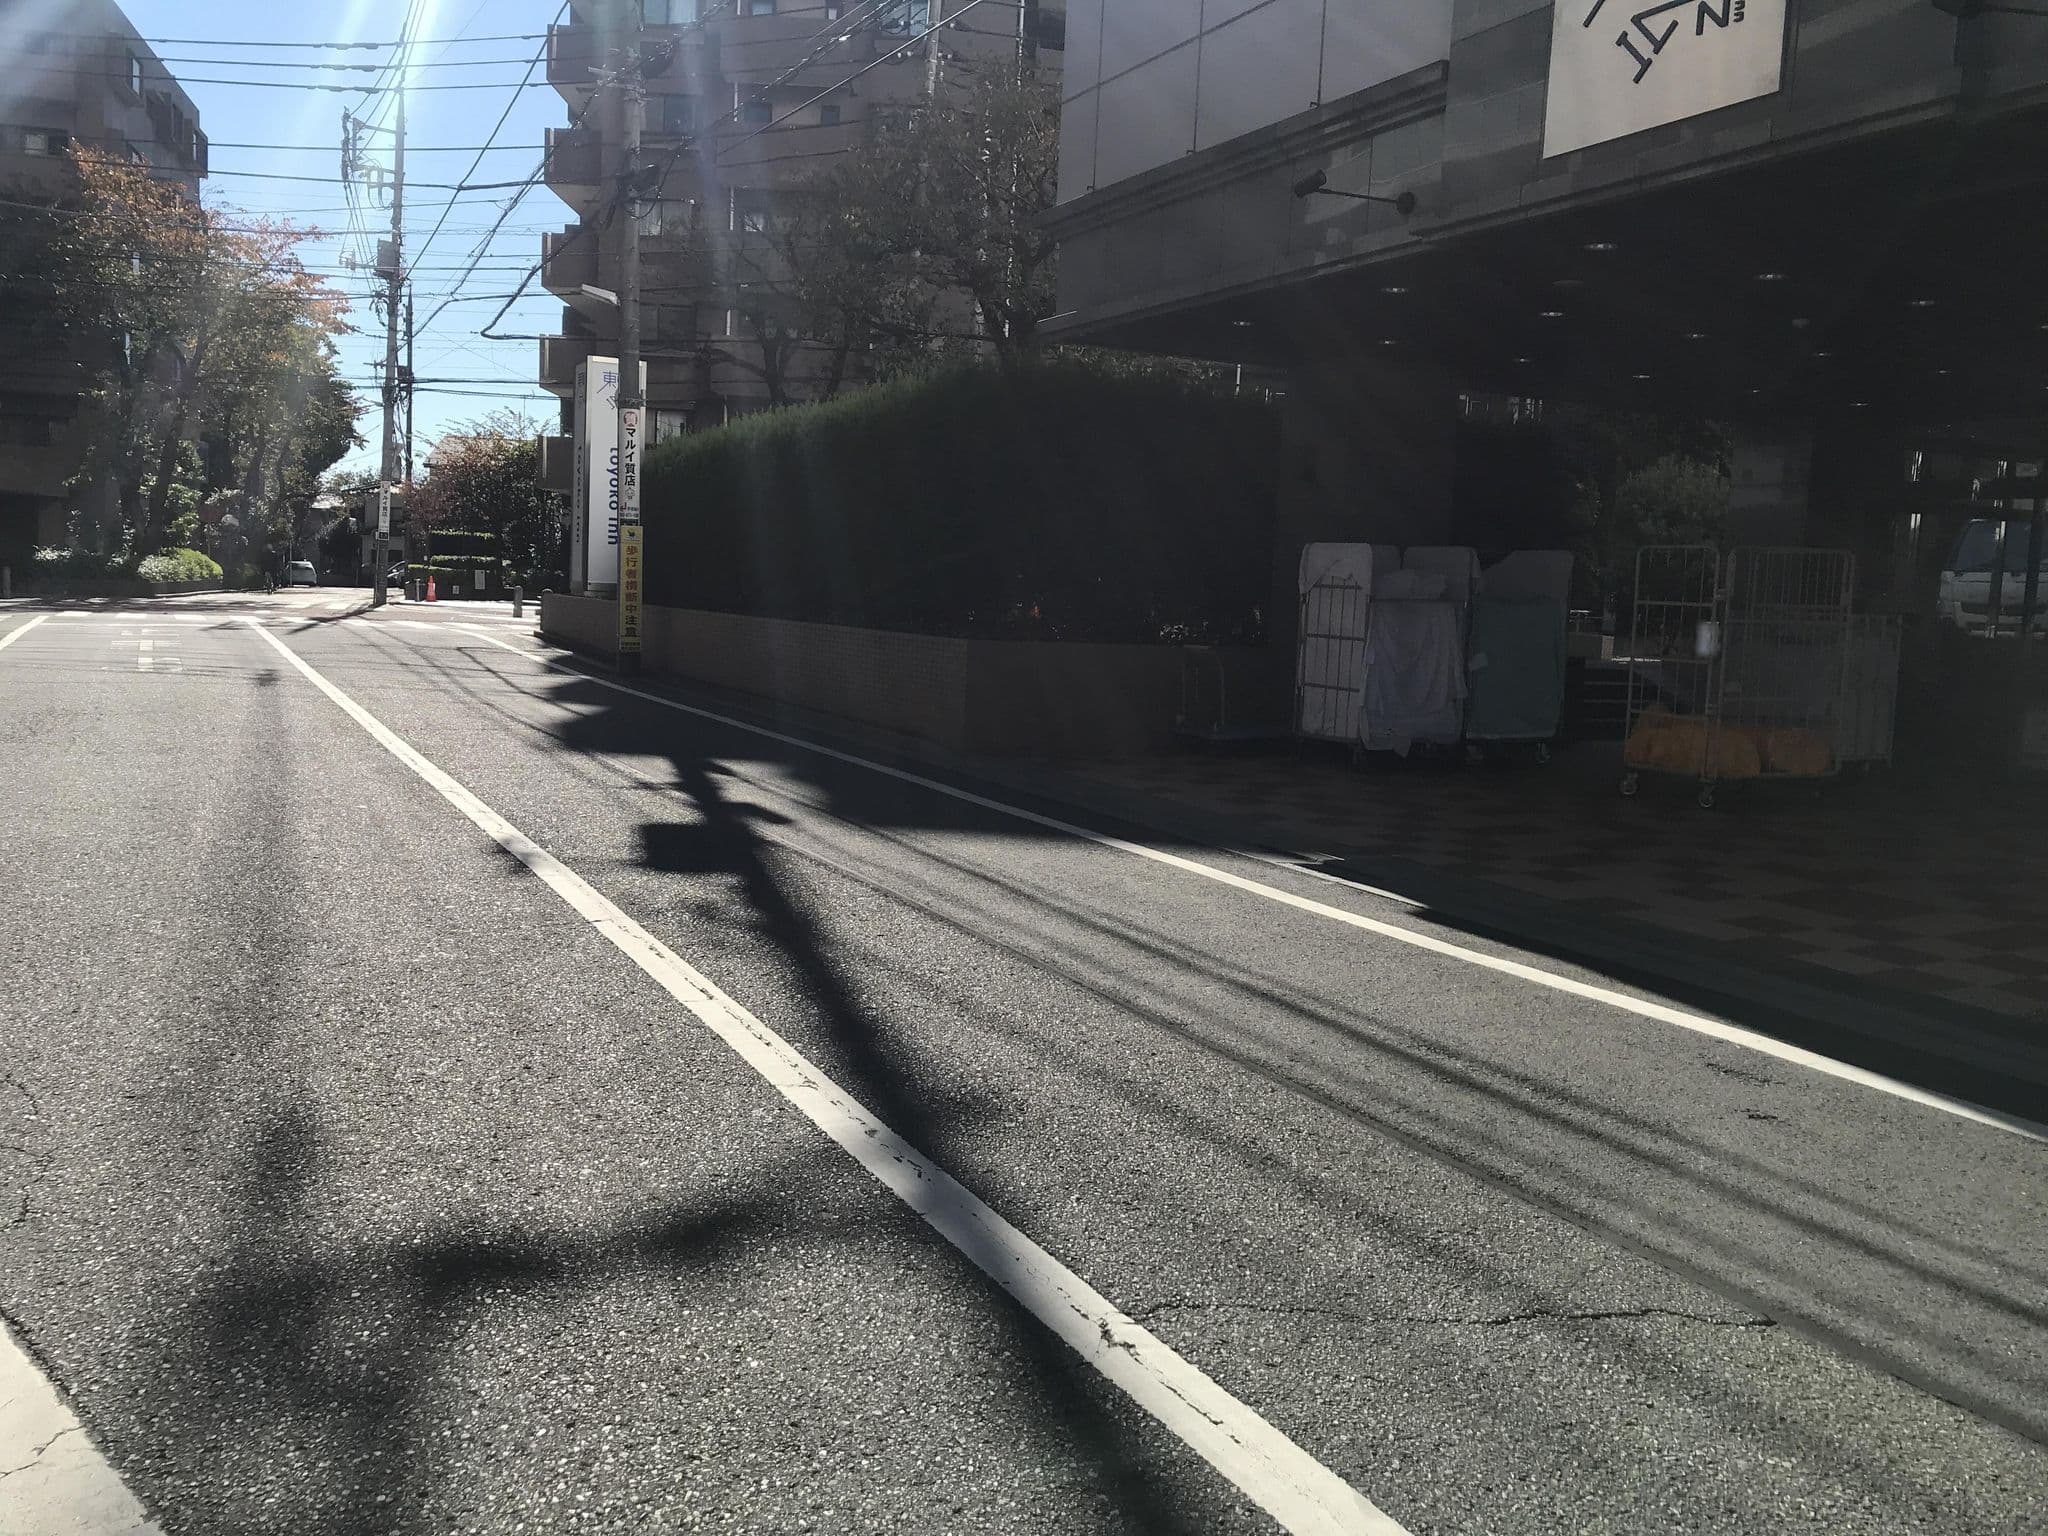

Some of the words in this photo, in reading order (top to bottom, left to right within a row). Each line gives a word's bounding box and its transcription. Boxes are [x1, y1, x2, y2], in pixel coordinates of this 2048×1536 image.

[625, 428, 636, 487] マルイ質店
